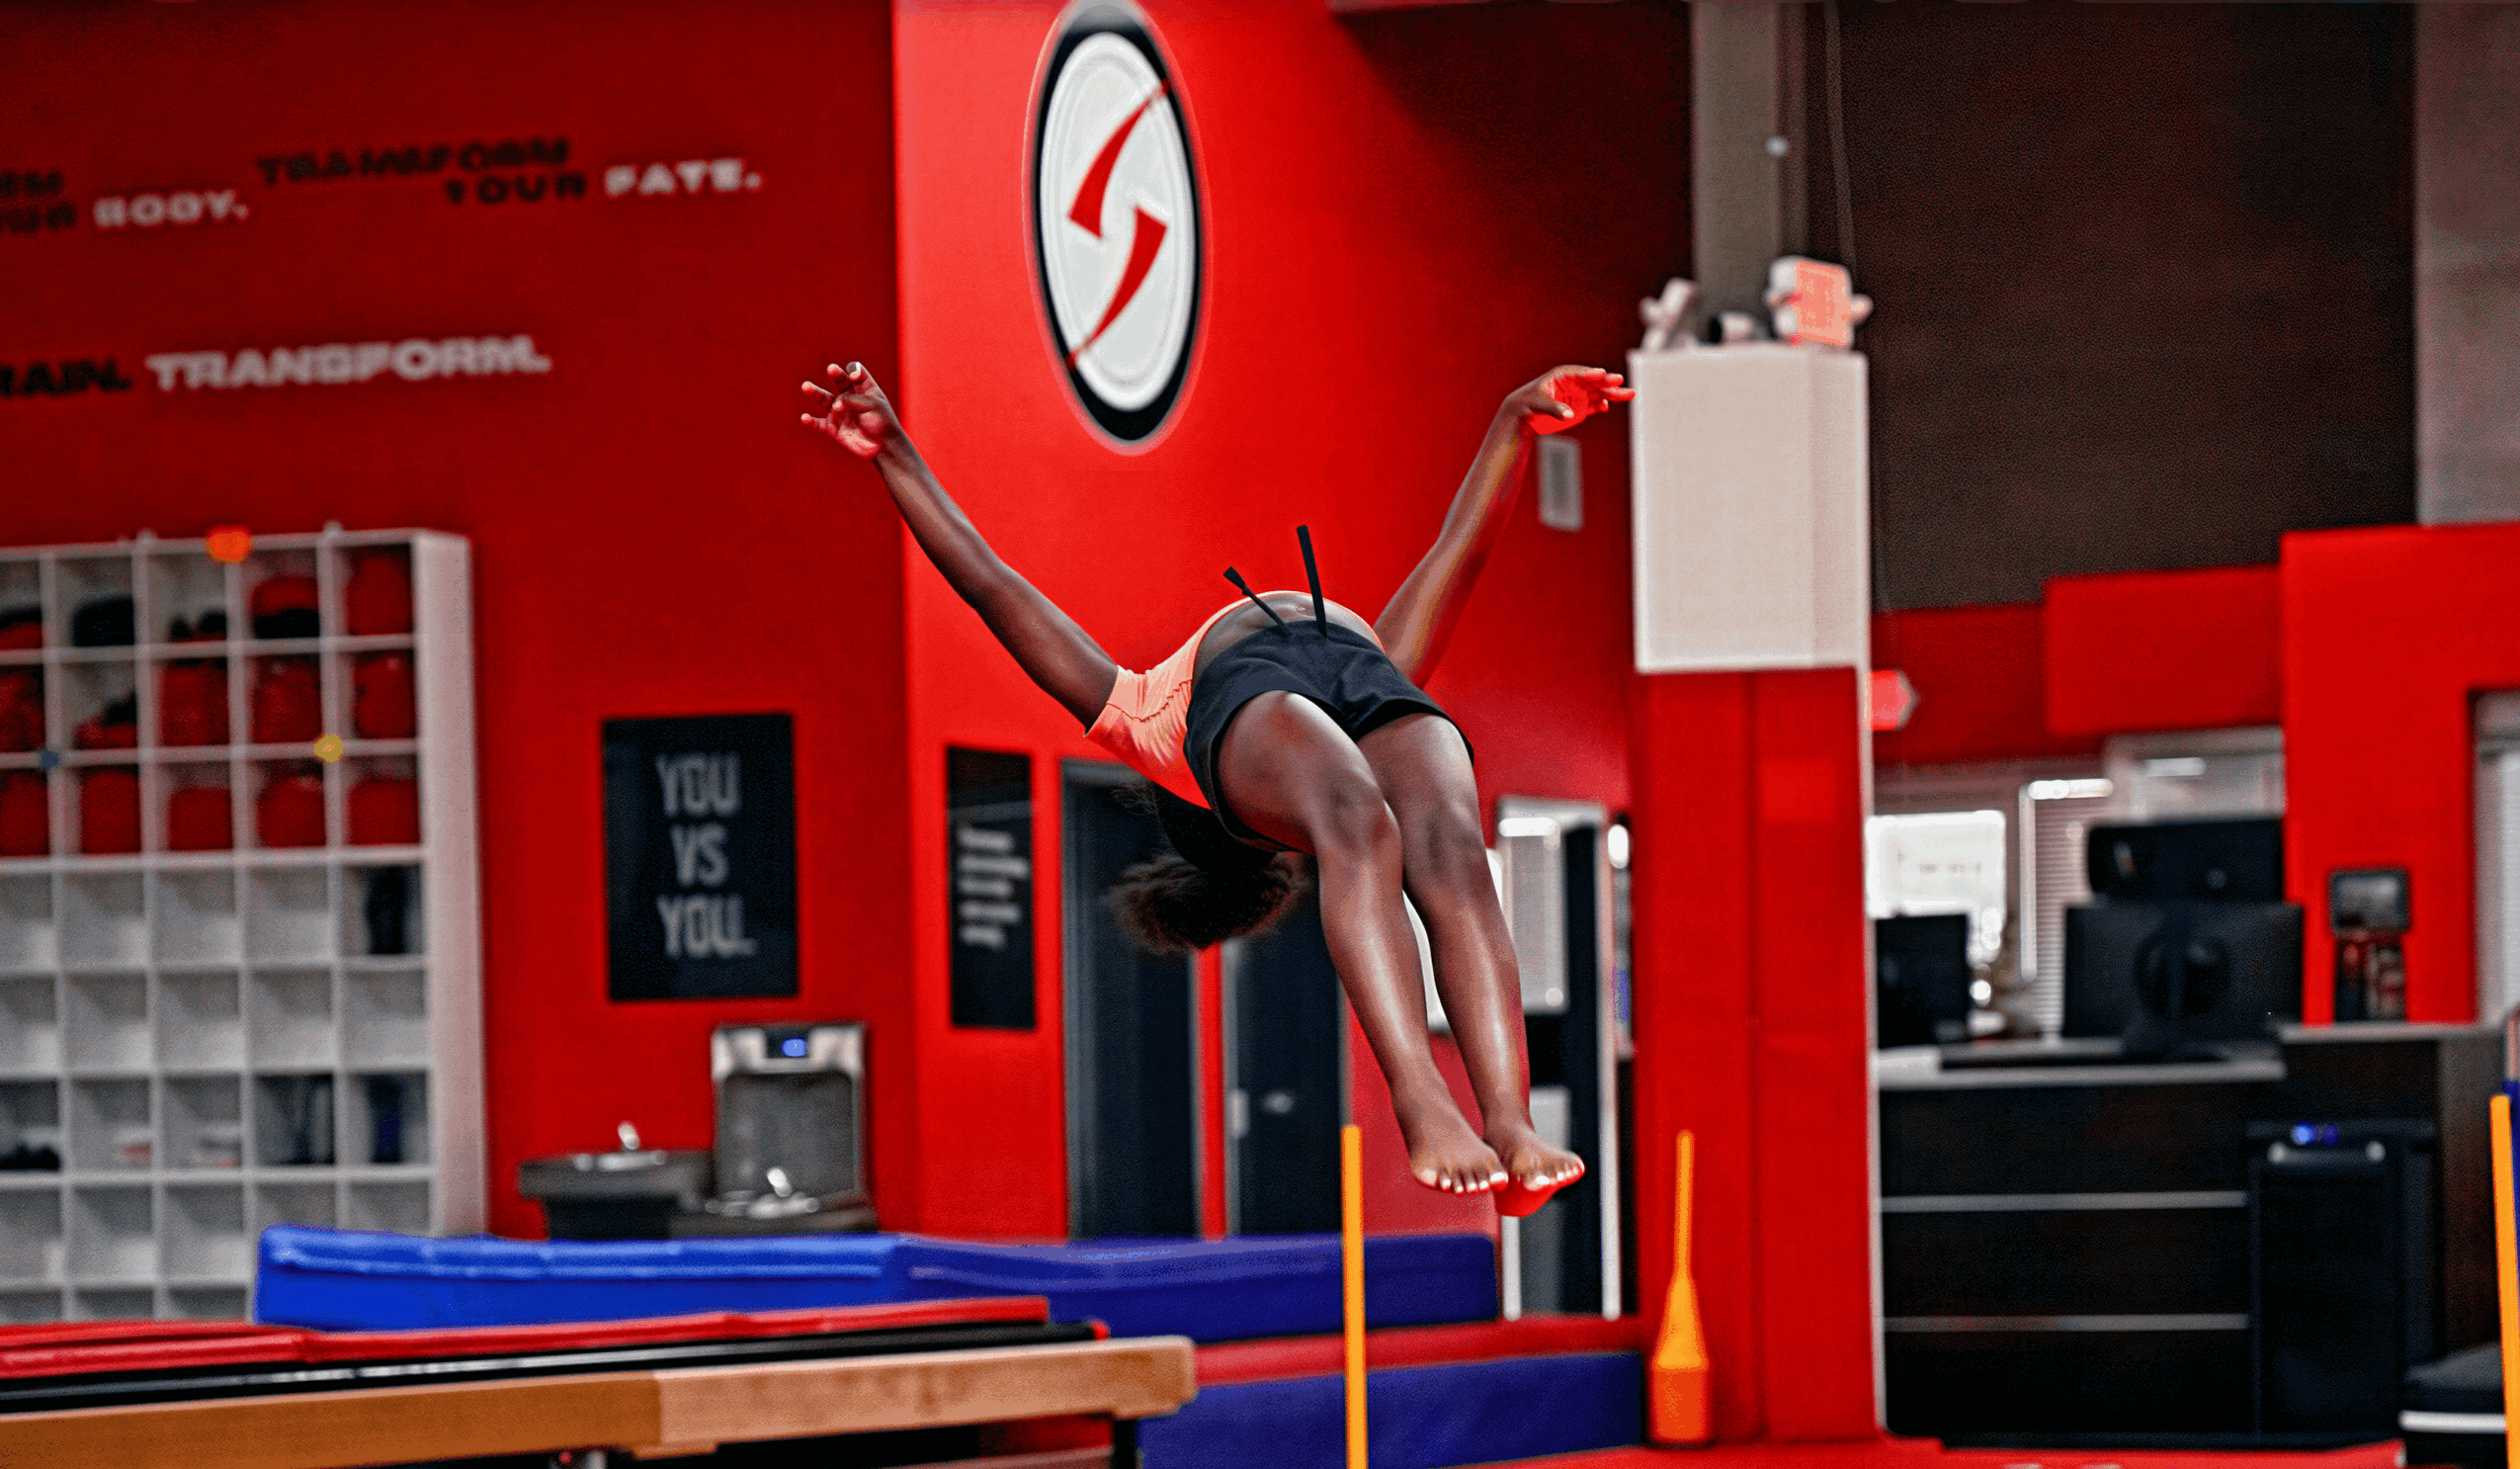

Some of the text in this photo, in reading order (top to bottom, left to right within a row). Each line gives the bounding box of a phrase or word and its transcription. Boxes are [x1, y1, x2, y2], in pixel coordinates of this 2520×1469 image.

[653, 749, 742, 819] YOU
[669, 821, 731, 889] VS
[654, 893, 759, 959] YOU.
